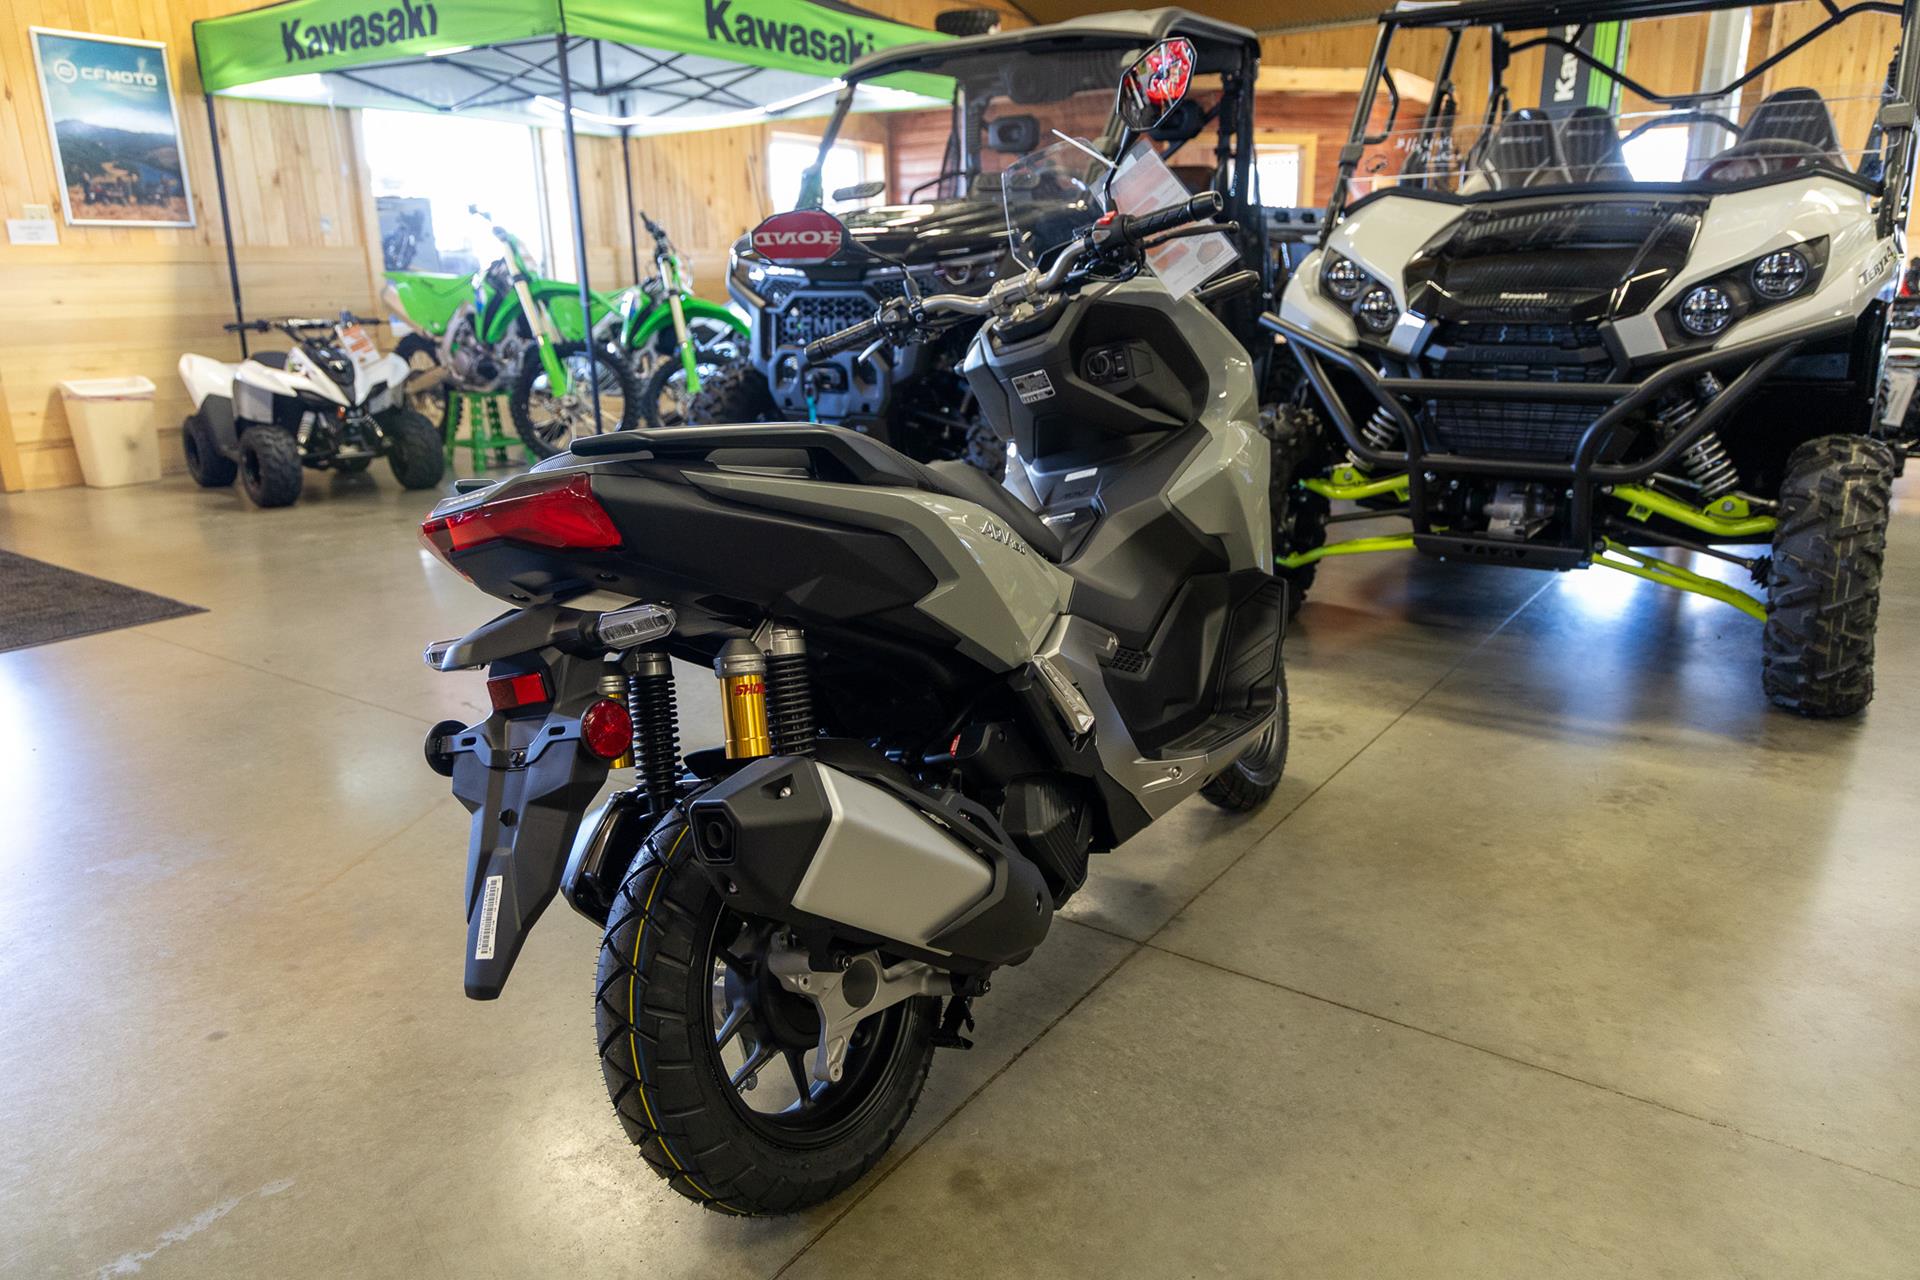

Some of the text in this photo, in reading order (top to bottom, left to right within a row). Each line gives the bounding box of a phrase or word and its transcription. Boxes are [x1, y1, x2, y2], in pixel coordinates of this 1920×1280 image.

[281, 0, 438, 63] Kawasaki
[80, 66, 158, 86] CFMOTO
[785, 316, 863, 338] CFMO
